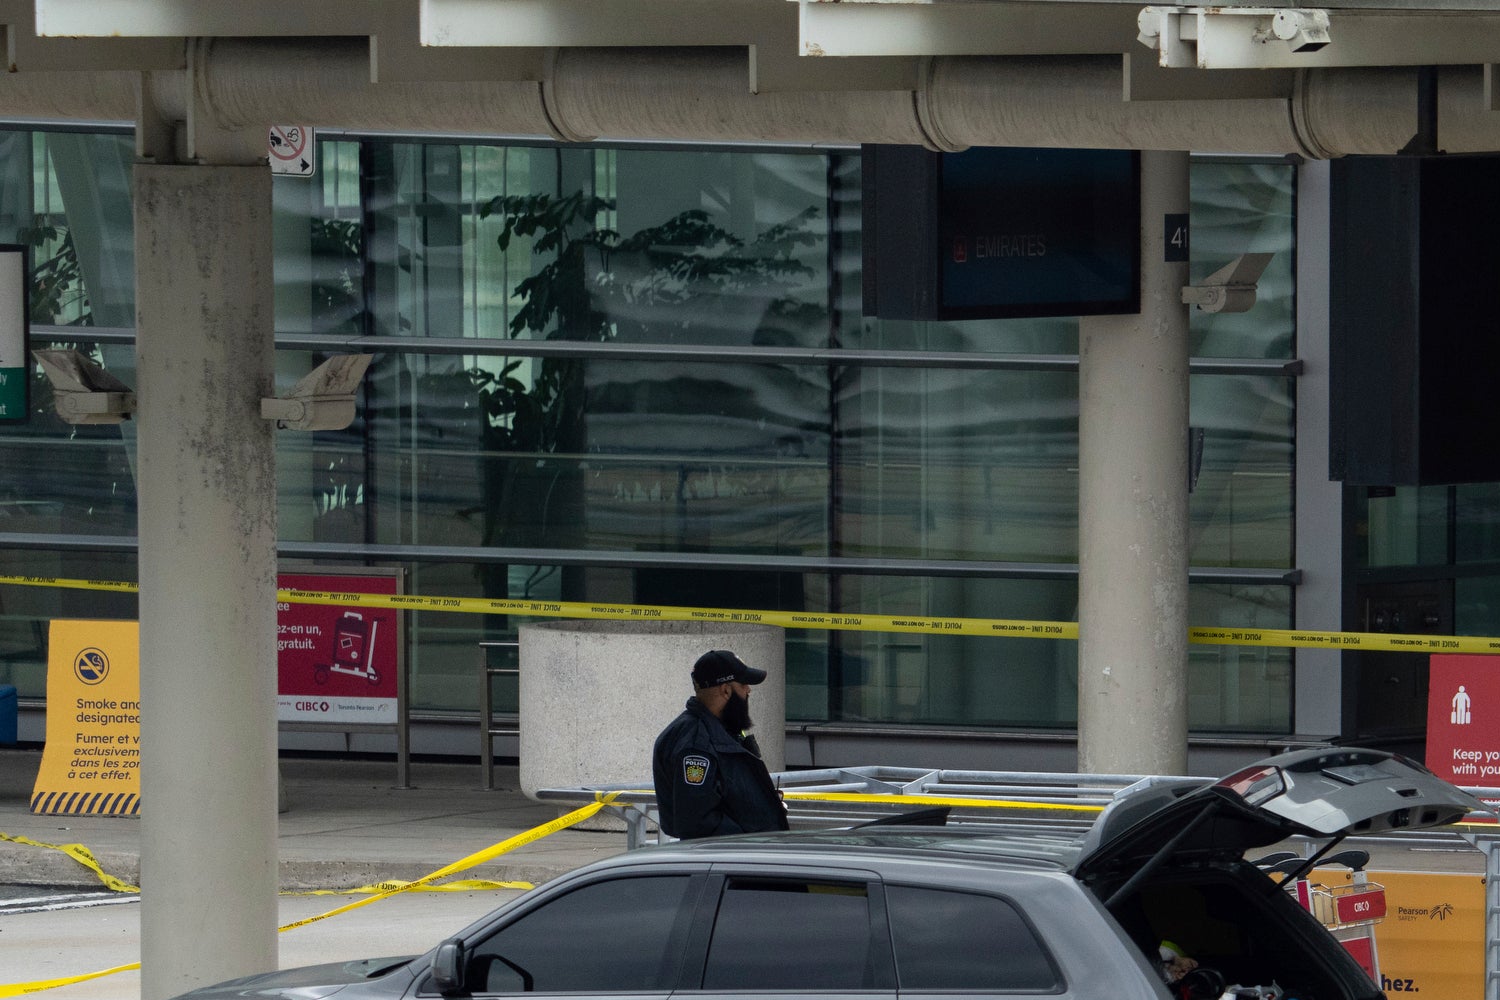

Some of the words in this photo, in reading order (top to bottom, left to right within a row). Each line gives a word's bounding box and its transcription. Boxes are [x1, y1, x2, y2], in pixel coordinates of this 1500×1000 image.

[1171, 227, 1188, 248] 41
[976, 234, 1047, 258] EMIRATES
[306, 625, 322, 636] un,
[278, 638, 315, 651] gratuit.
[76, 698, 117, 710] Smoke
[295, 702, 318, 711] CIBC
[76, 733, 114, 744] Fumer
[118, 734, 129, 744] et
[1453, 749, 1482, 762] Keep
[71, 758, 100, 768] dans
[104, 759, 119, 768] les
[68, 769, 76, 779] à
[79, 770, 97, 779] cet
[101, 770, 131, 780] effet.
[1452, 763, 1476, 775] with
[1479, 765, 1500, 778] you
[1398, 907, 1428, 915] Pearson
